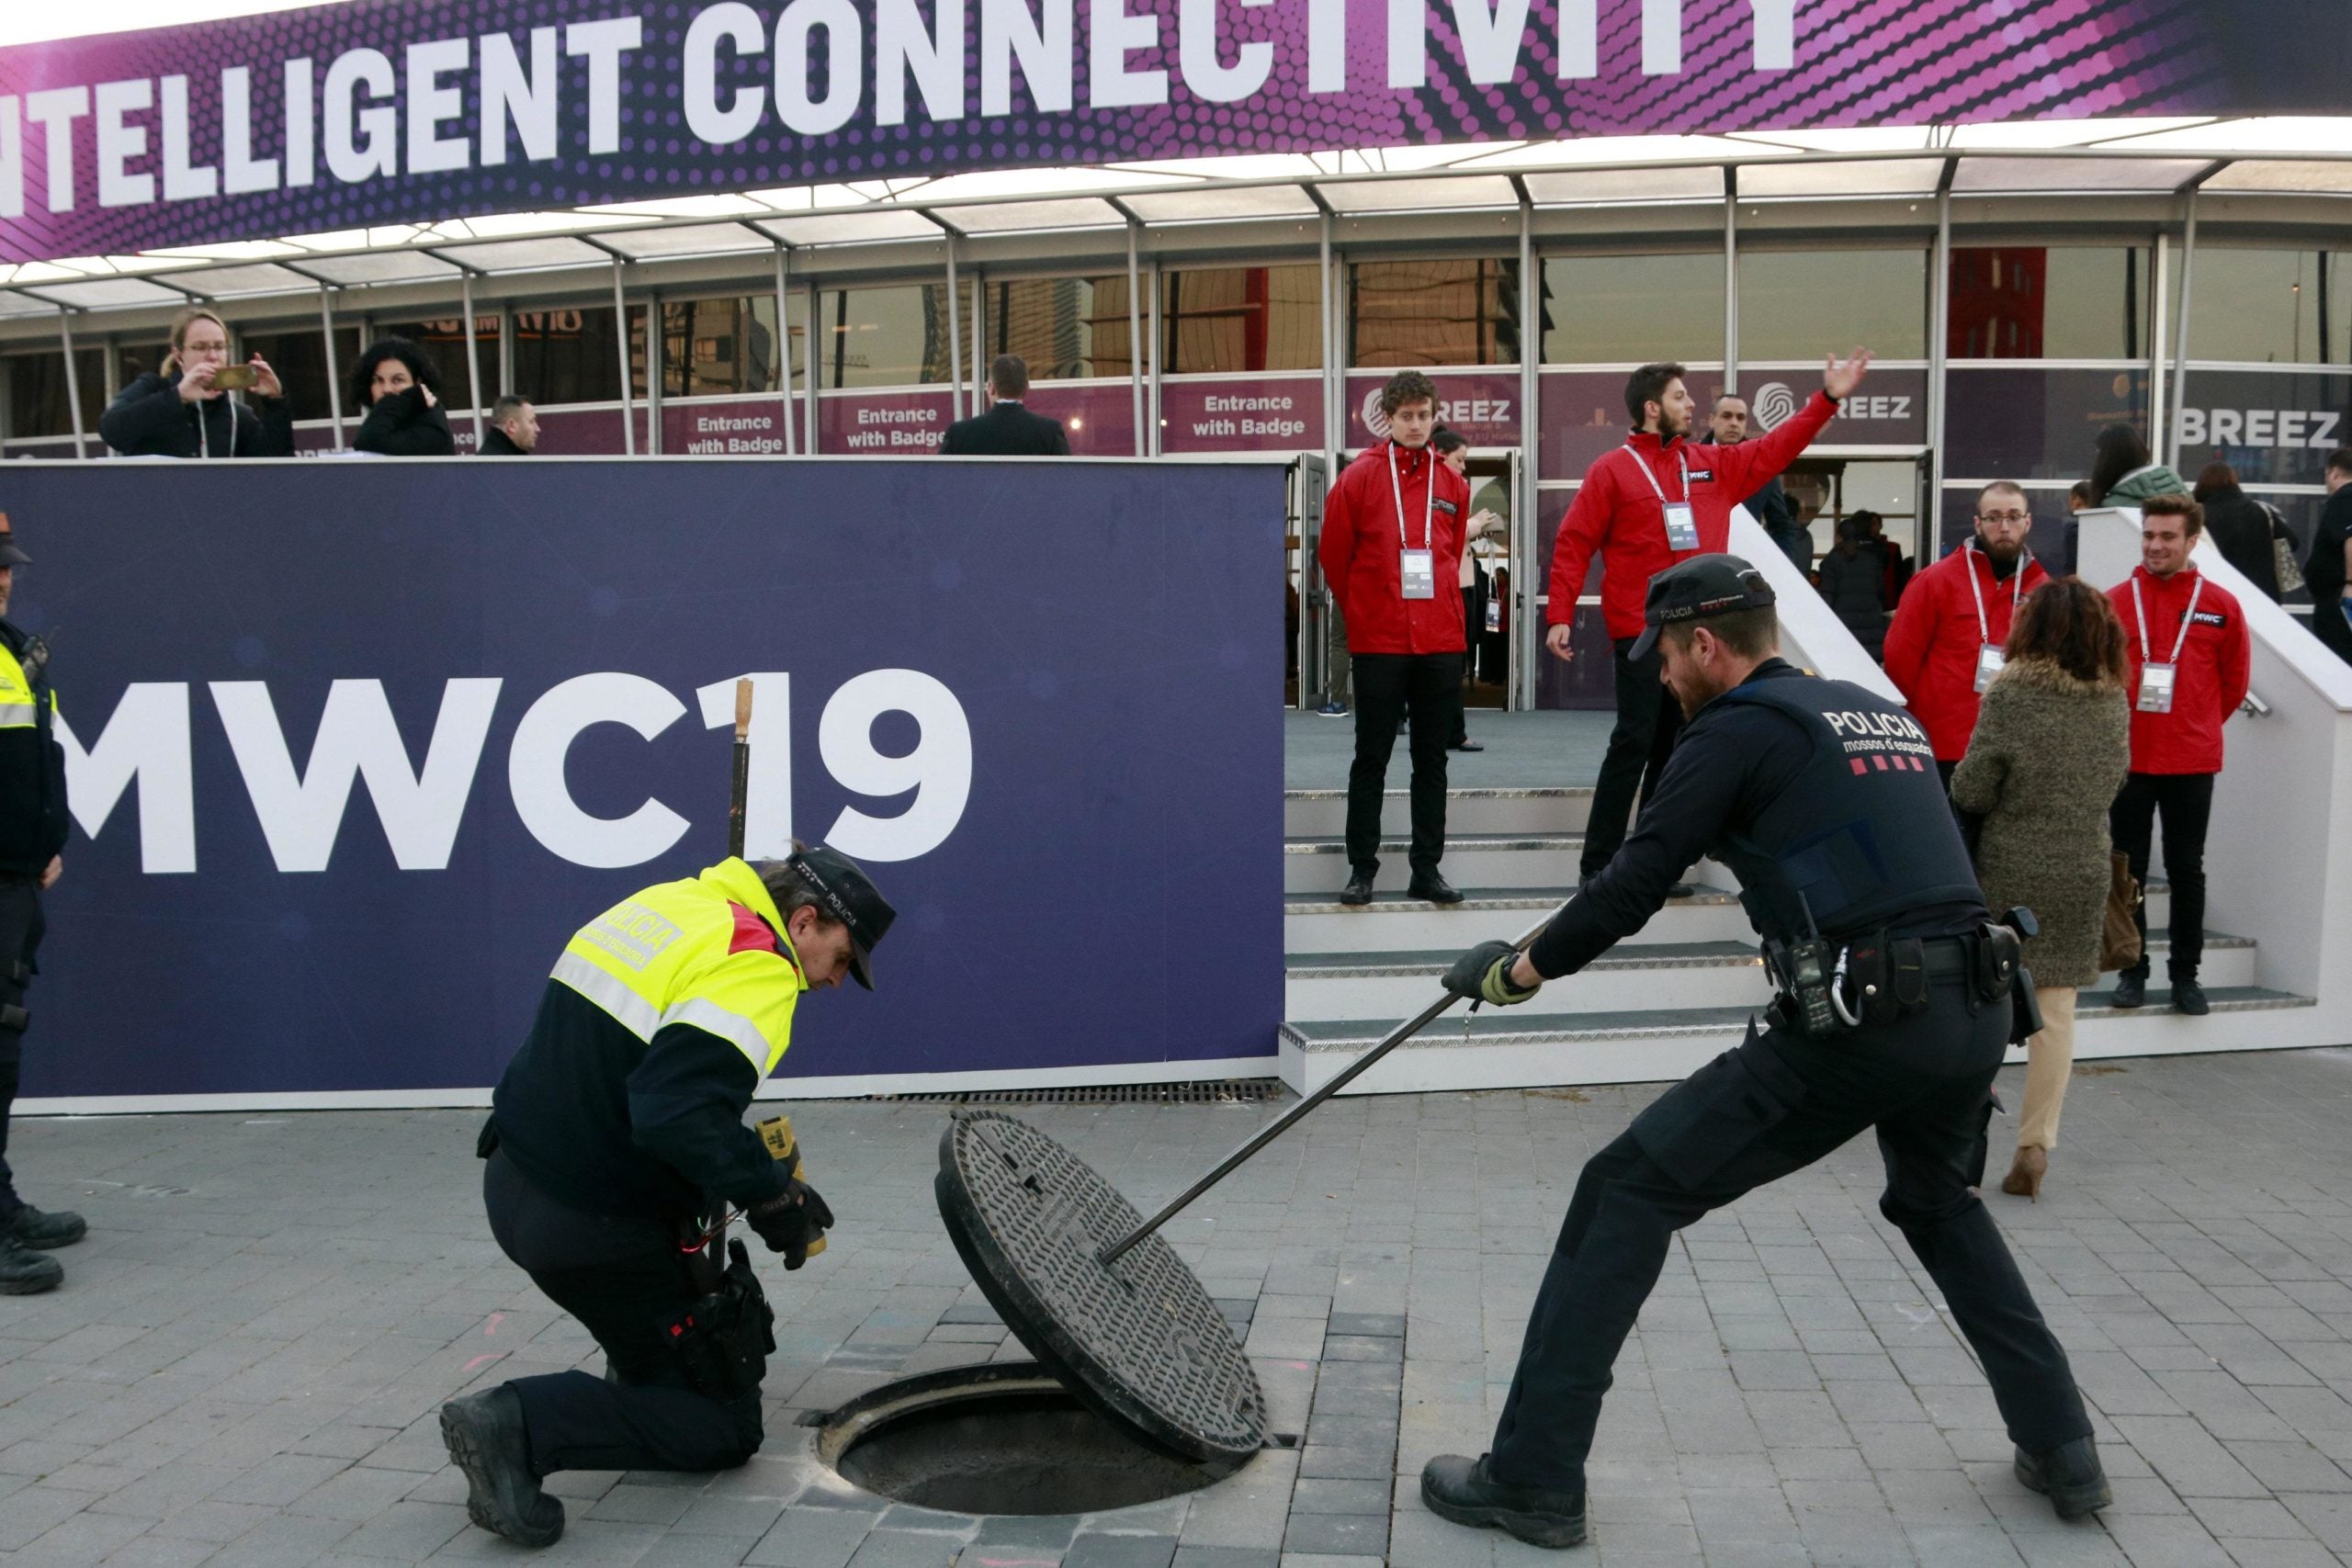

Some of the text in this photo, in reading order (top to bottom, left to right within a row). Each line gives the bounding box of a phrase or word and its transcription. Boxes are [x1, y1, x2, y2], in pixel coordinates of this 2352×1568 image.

[1204, 396, 1293, 412] Entrance
[1433, 400, 1510, 422] REEZ
[1806, 396, 1911, 419] REEZ
[697, 416, 772, 433] Entrance
[857, 409, 937, 424] Entrance
[1193, 419, 1305, 437] with Badge
[2178, 407, 2340, 448] BREEZ
[687, 436, 783, 455] with Badge
[847, 431, 885, 447] with
[1659, 606, 1694, 619] POLICIA
[2194, 613, 2223, 624] MWC
[1822, 711, 1927, 741] POLICIA
[1843, 739, 1883, 752] mossos
[52, 668, 973, 874] MWC19
[827, 892, 857, 927] POLICIA
